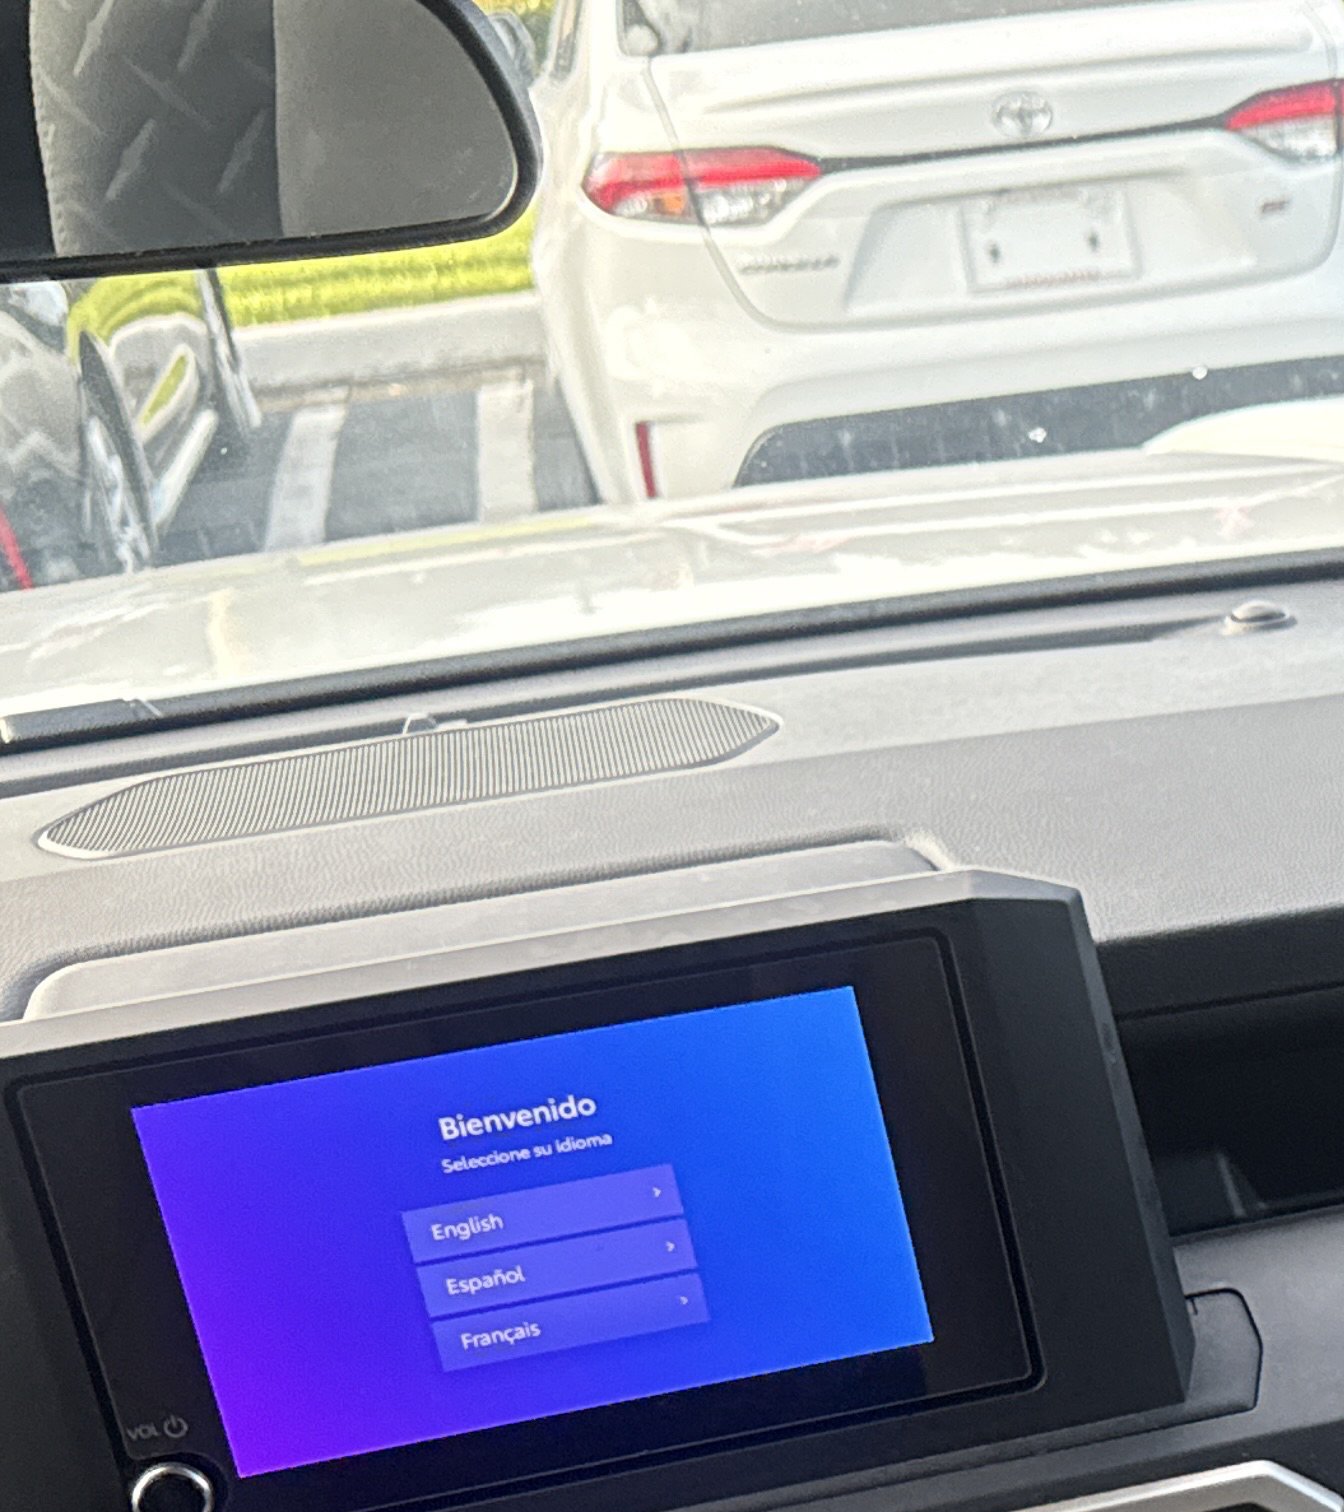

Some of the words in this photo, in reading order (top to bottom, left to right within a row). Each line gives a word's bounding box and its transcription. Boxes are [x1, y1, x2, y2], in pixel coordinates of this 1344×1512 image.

[438, 1094, 597, 1141] Bienvenido
[441, 1147, 531, 1174] Seleccione
[533, 1143, 553, 1157] su
[557, 1132, 613, 1154] idioma
[430, 1213, 504, 1242] English
[446, 1265, 526, 1296] Español
[460, 1321, 541, 1351] Français
[126, 1422, 160, 1440] VOL
